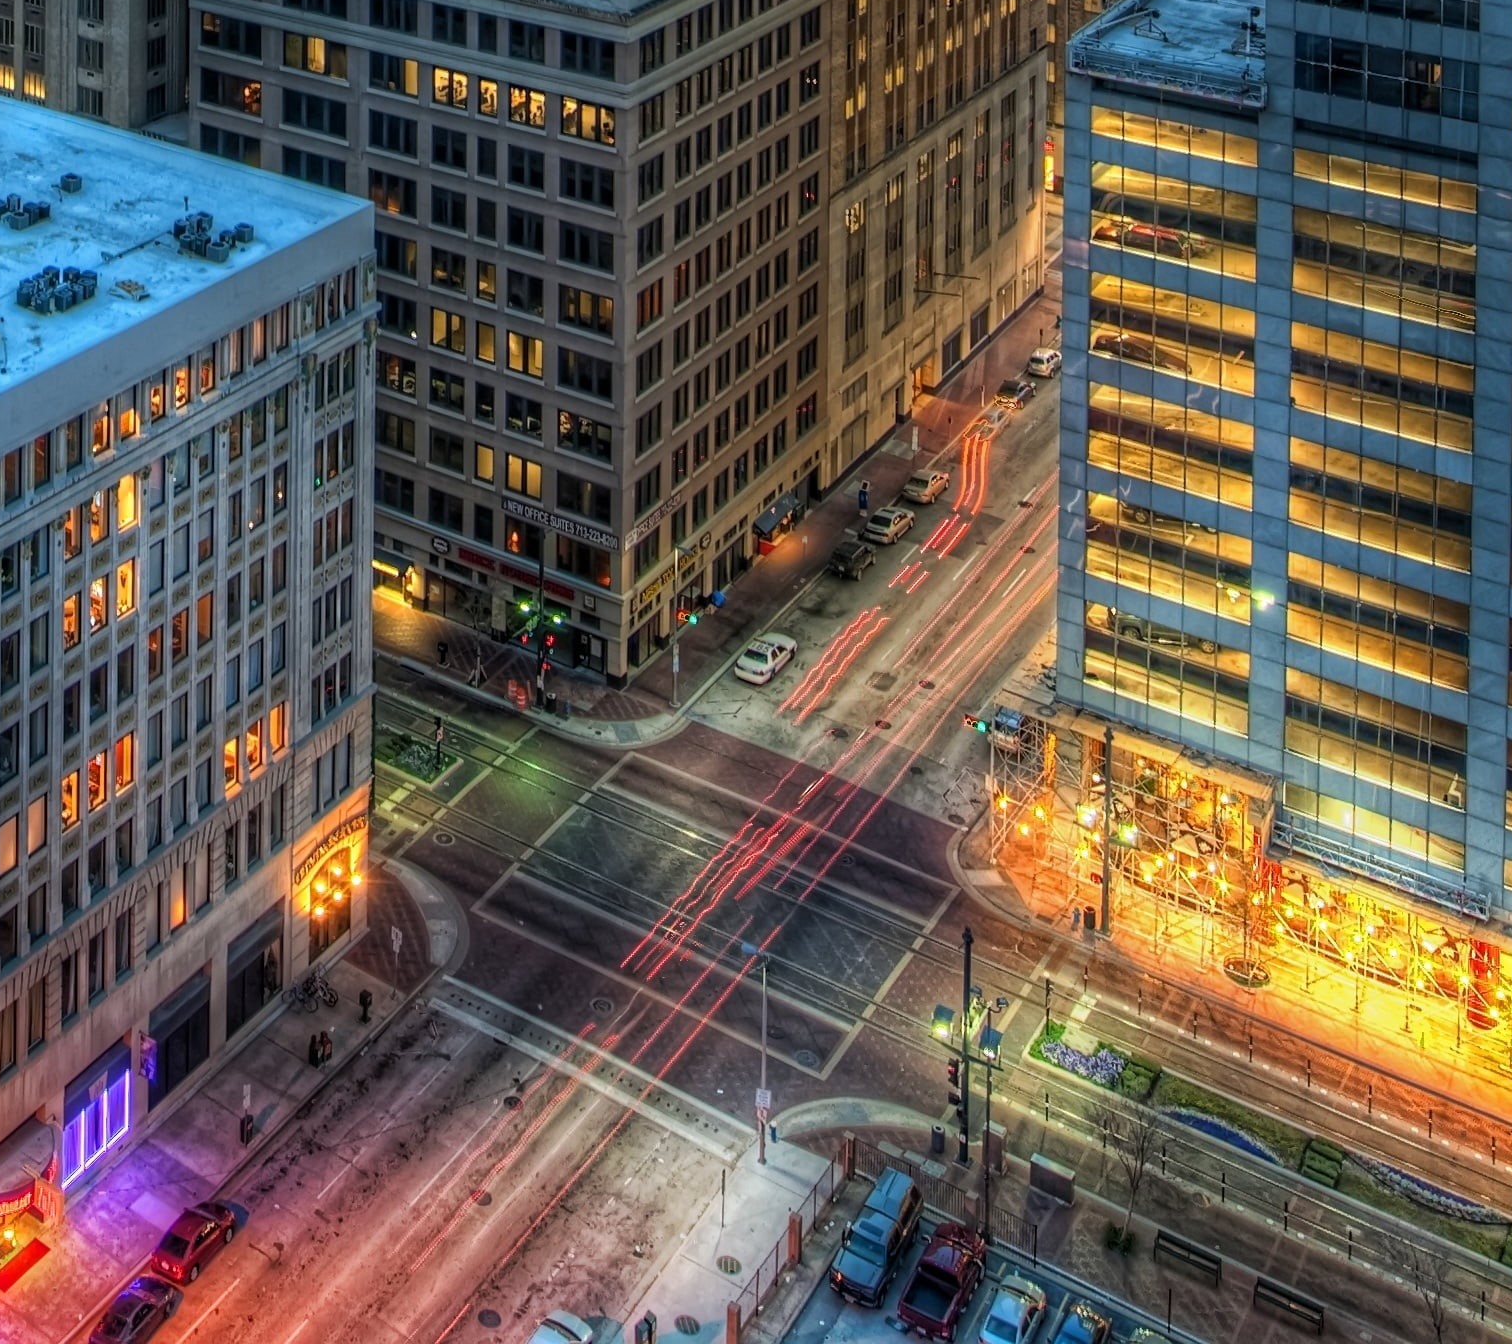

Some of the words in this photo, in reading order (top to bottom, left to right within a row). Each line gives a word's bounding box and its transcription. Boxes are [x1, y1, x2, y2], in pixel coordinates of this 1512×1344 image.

[508, 500, 524, 516] NEW
[525, 506, 549, 524] OFFICE
[550, 516, 574, 533] SUITES
